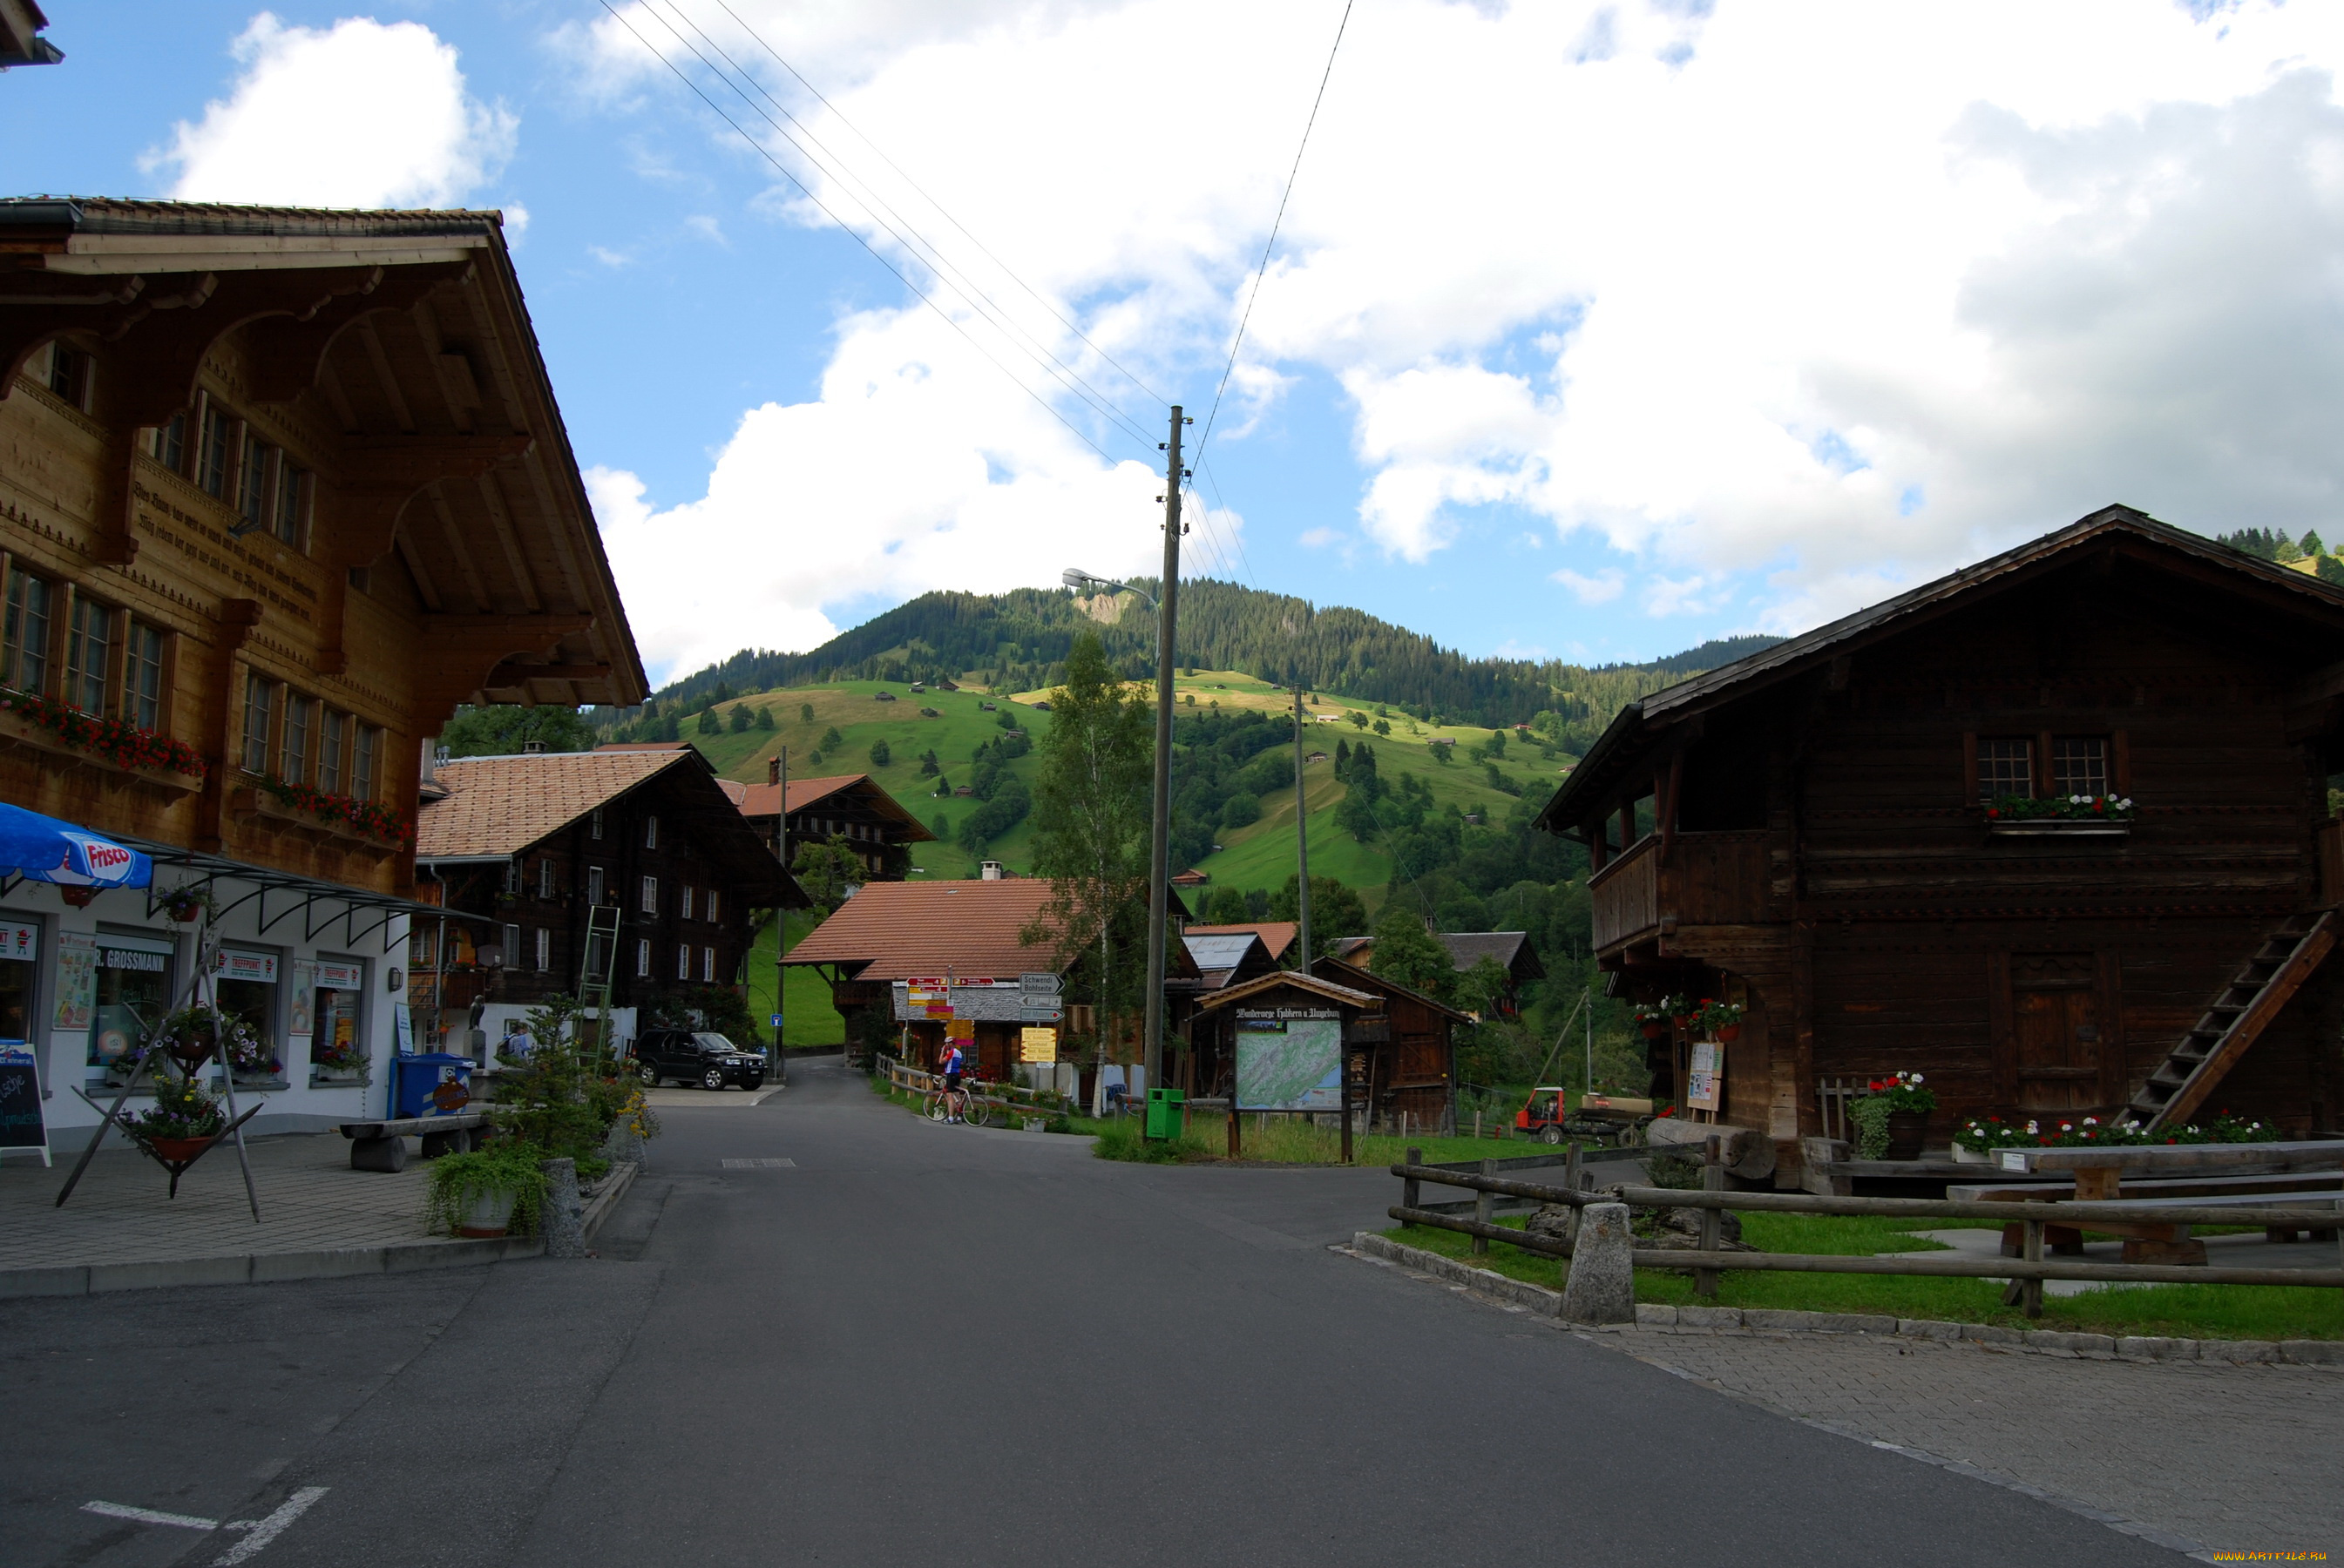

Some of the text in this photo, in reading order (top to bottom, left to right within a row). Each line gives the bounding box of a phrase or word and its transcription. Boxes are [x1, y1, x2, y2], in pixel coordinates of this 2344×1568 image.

[133, 481, 150, 503] Dies
[87, 845, 130, 868] Frisco
[107, 950, 165, 972] GROSSMANN
[232, 958, 261, 970] TREFFPUNKT
[324, 969, 348, 979] TREFFPUNKT
[1236, 1008, 1275, 1018] Wanderwege
[1276, 1008, 1303, 1019] Habkern
[1309, 1008, 1340, 1018] Umgebung
